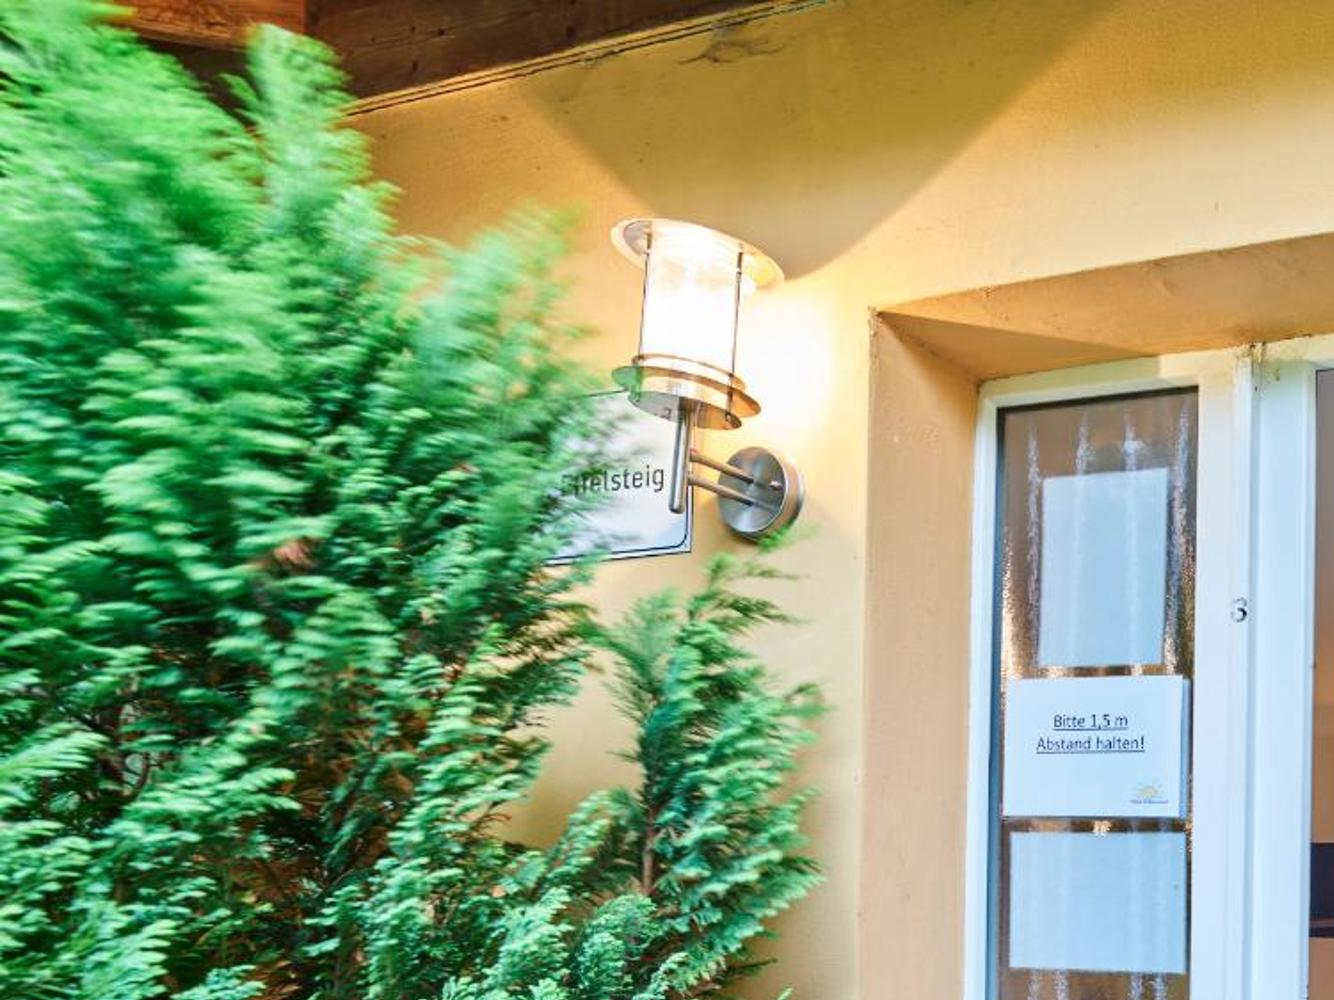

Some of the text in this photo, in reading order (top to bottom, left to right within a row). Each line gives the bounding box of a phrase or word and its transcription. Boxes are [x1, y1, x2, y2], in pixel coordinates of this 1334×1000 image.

[562, 464, 665, 495] felsteig
[1053, 713, 1128, 730] Bitte 1,5 m
[1037, 735, 1144, 751] Abstand halten!
